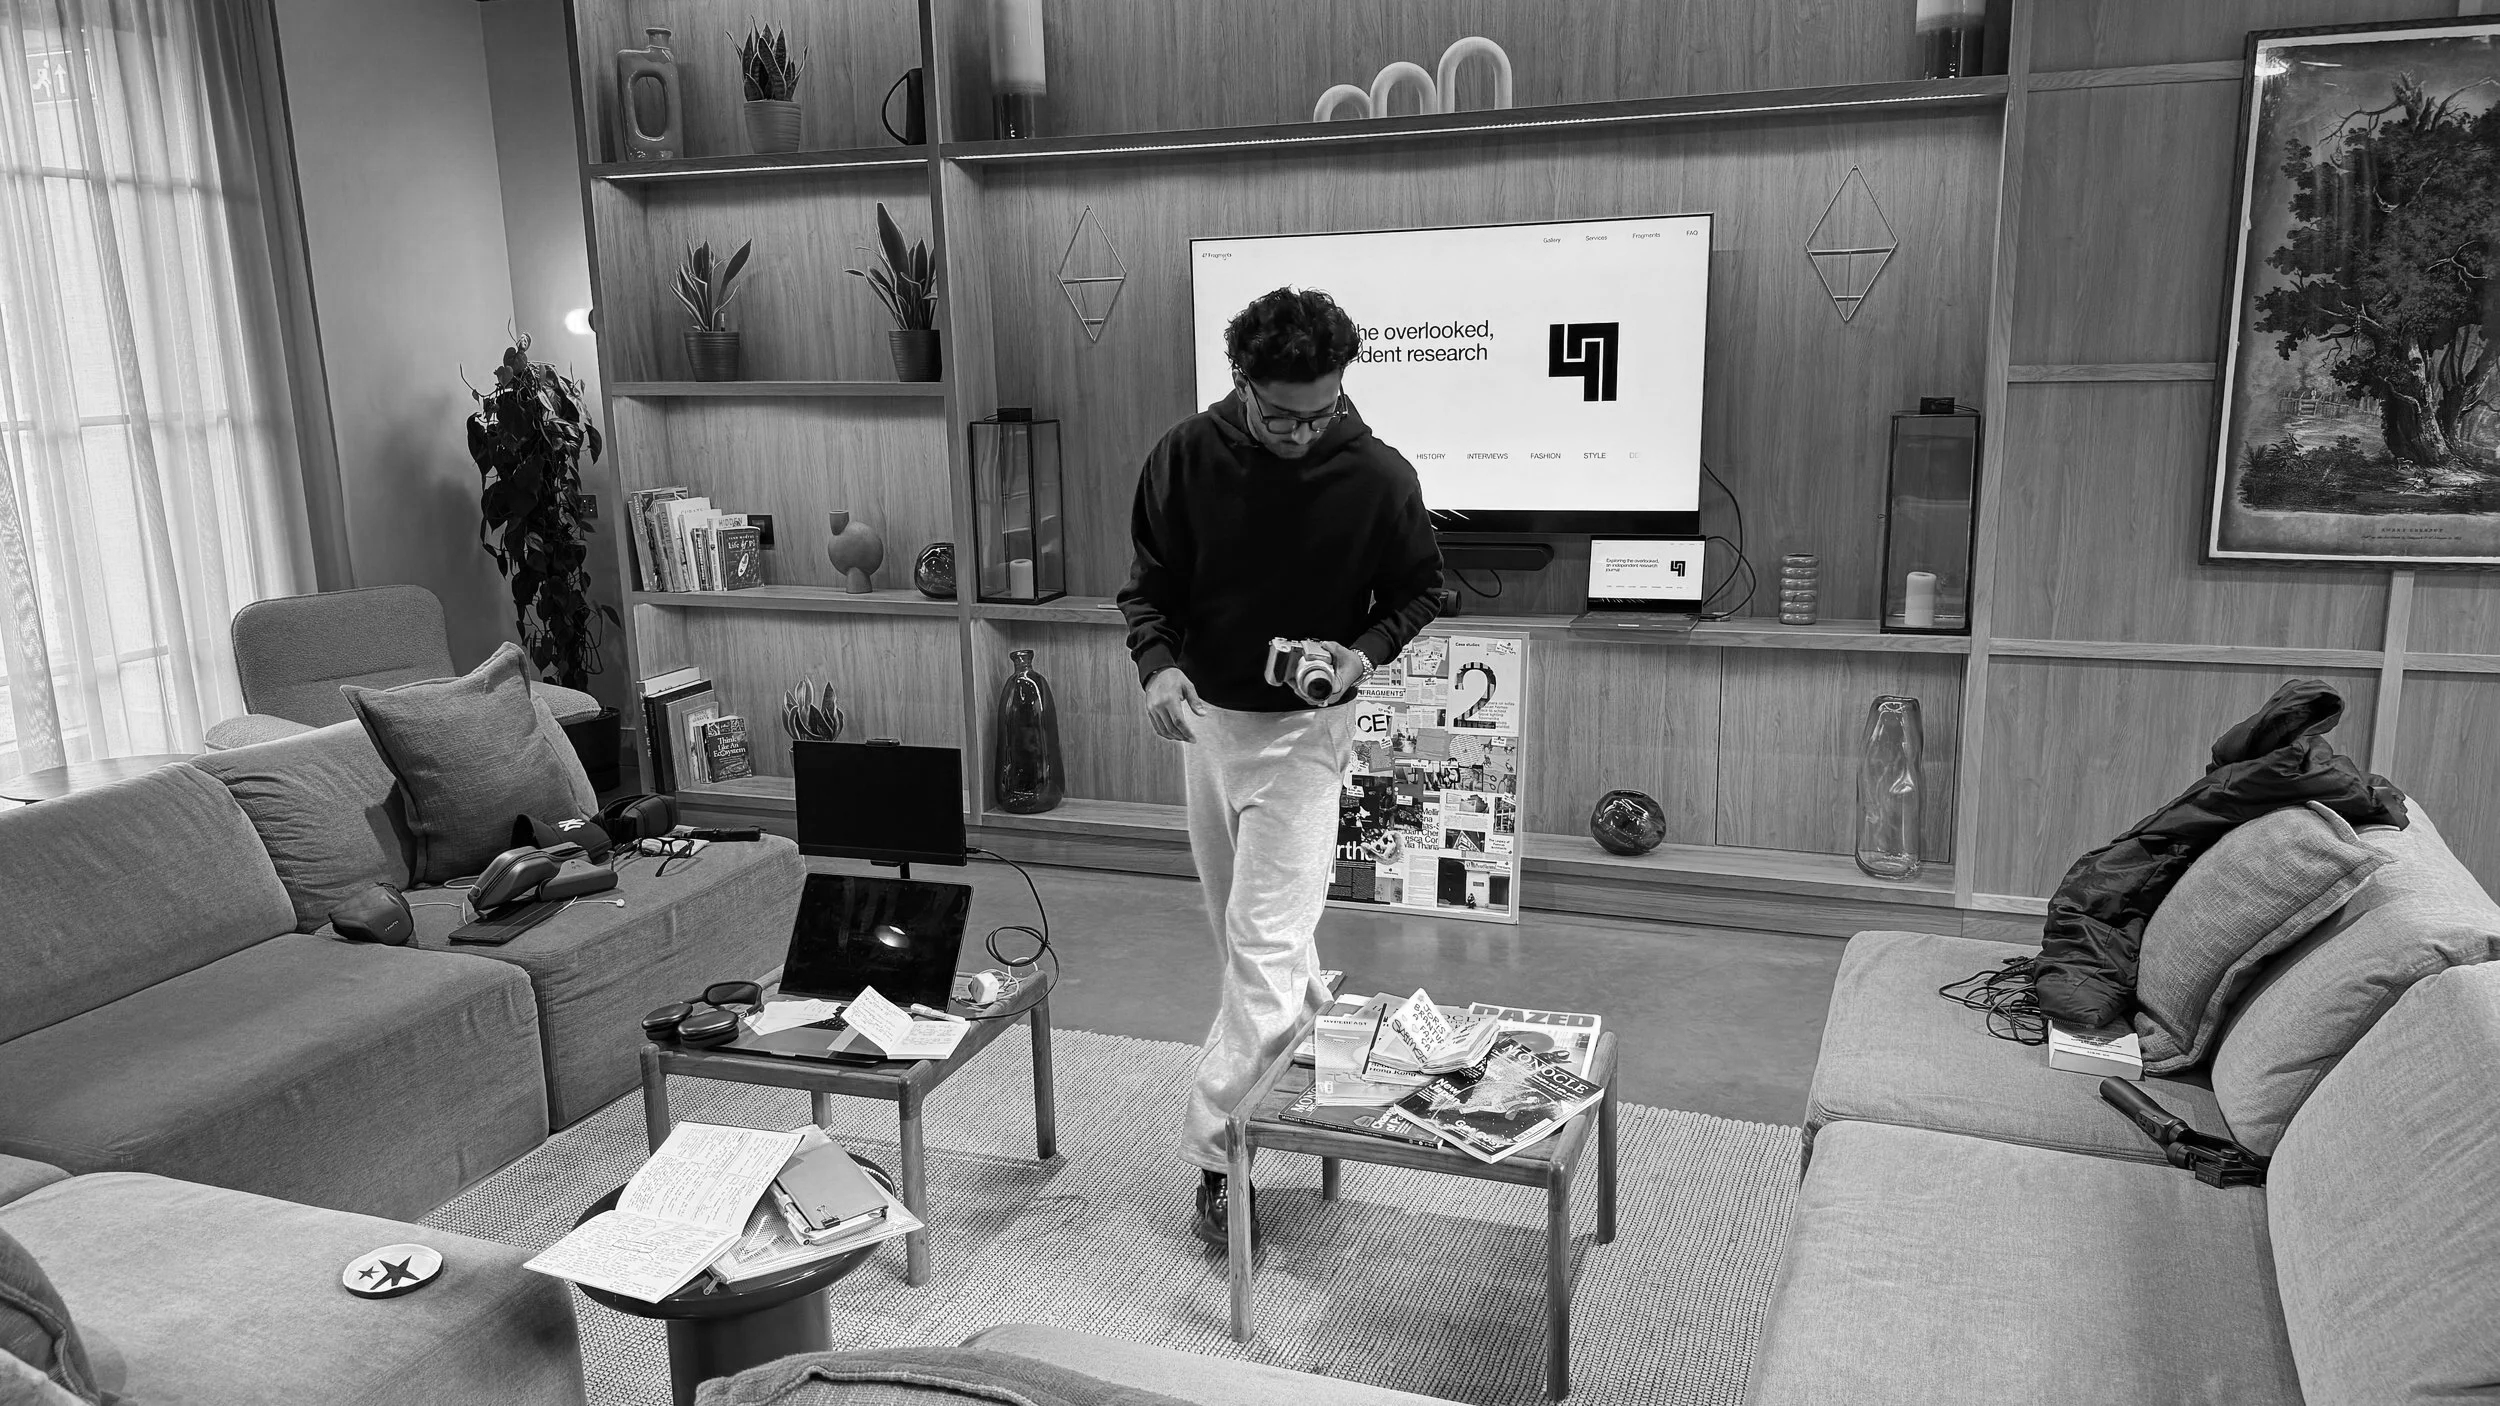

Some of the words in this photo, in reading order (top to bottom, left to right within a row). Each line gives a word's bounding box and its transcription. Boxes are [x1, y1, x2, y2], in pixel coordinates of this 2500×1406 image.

[1357, 323, 1379, 340] he
[1384, 320, 1494, 341] overlooked,
[1357, 346, 1402, 363] dent
[1407, 343, 1488, 362] research
[1416, 452, 1446, 460] HISTORY
[1467, 452, 1509, 460] INTERVIEWS
[1530, 452, 1562, 460] FASHION
[1583, 452, 1606, 460] STYLE
[728, 541, 739, 549] Life
[1453, 662, 1497, 729] 2
[1357, 714, 1392, 733] CE
[717, 735, 737, 744] Think
[1472, 1005, 1595, 1028] DAZED
[1502, 1044, 1589, 1094] MONOCLE
[1428, 1084, 1461, 1104] Japan
[1435, 1078, 1461, 1096] New
[1290, 1087, 1317, 1113] MONO
[1455, 1119, 1475, 1136] Get
[1476, 1130, 1505, 1148] Cosy
